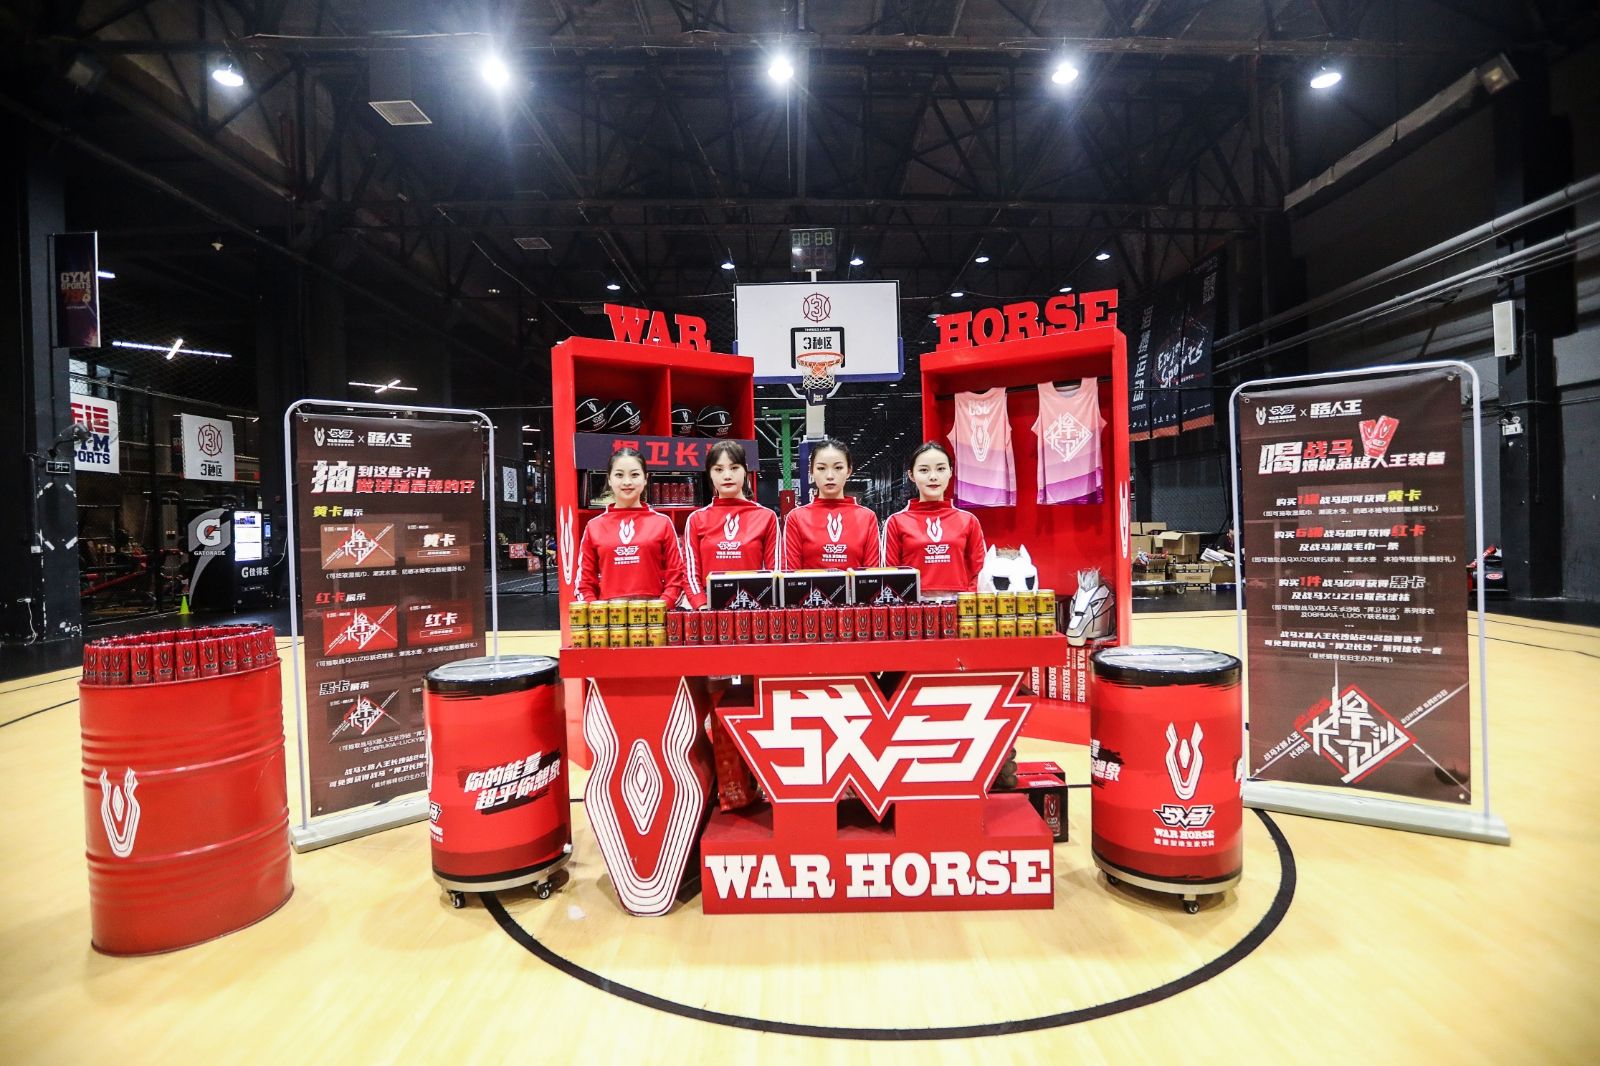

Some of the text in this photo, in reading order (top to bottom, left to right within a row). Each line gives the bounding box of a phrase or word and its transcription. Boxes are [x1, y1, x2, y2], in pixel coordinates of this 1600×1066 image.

[61, 271, 91, 283] GYM
[604, 303, 711, 352] WAR
[935, 289, 1118, 352] HORSE
[803, 336, 832, 350] 3秒区
[1310, 399, 1362, 416] 路人王
[367, 431, 412, 445] 路人王
[1258, 439, 1353, 475] 喝 战马
[311, 460, 432, 494] 抽 到这些卡片
[422, 534, 456, 548] 黄卡
[315, 592, 367, 604] 红卡展示
[425, 612, 458, 628] 红卡
[319, 680, 370, 696] 黑卡展示
[1077, 672, 1085, 703] HORSE
[747, 684, 1011, 793] 战马
[464, 751, 543, 793] 你的能量
[474, 758, 561, 810] 超乎你想象
[1154, 827, 1215, 840] WAR HORSE
[705, 849, 1052, 899] WAR HORSE
